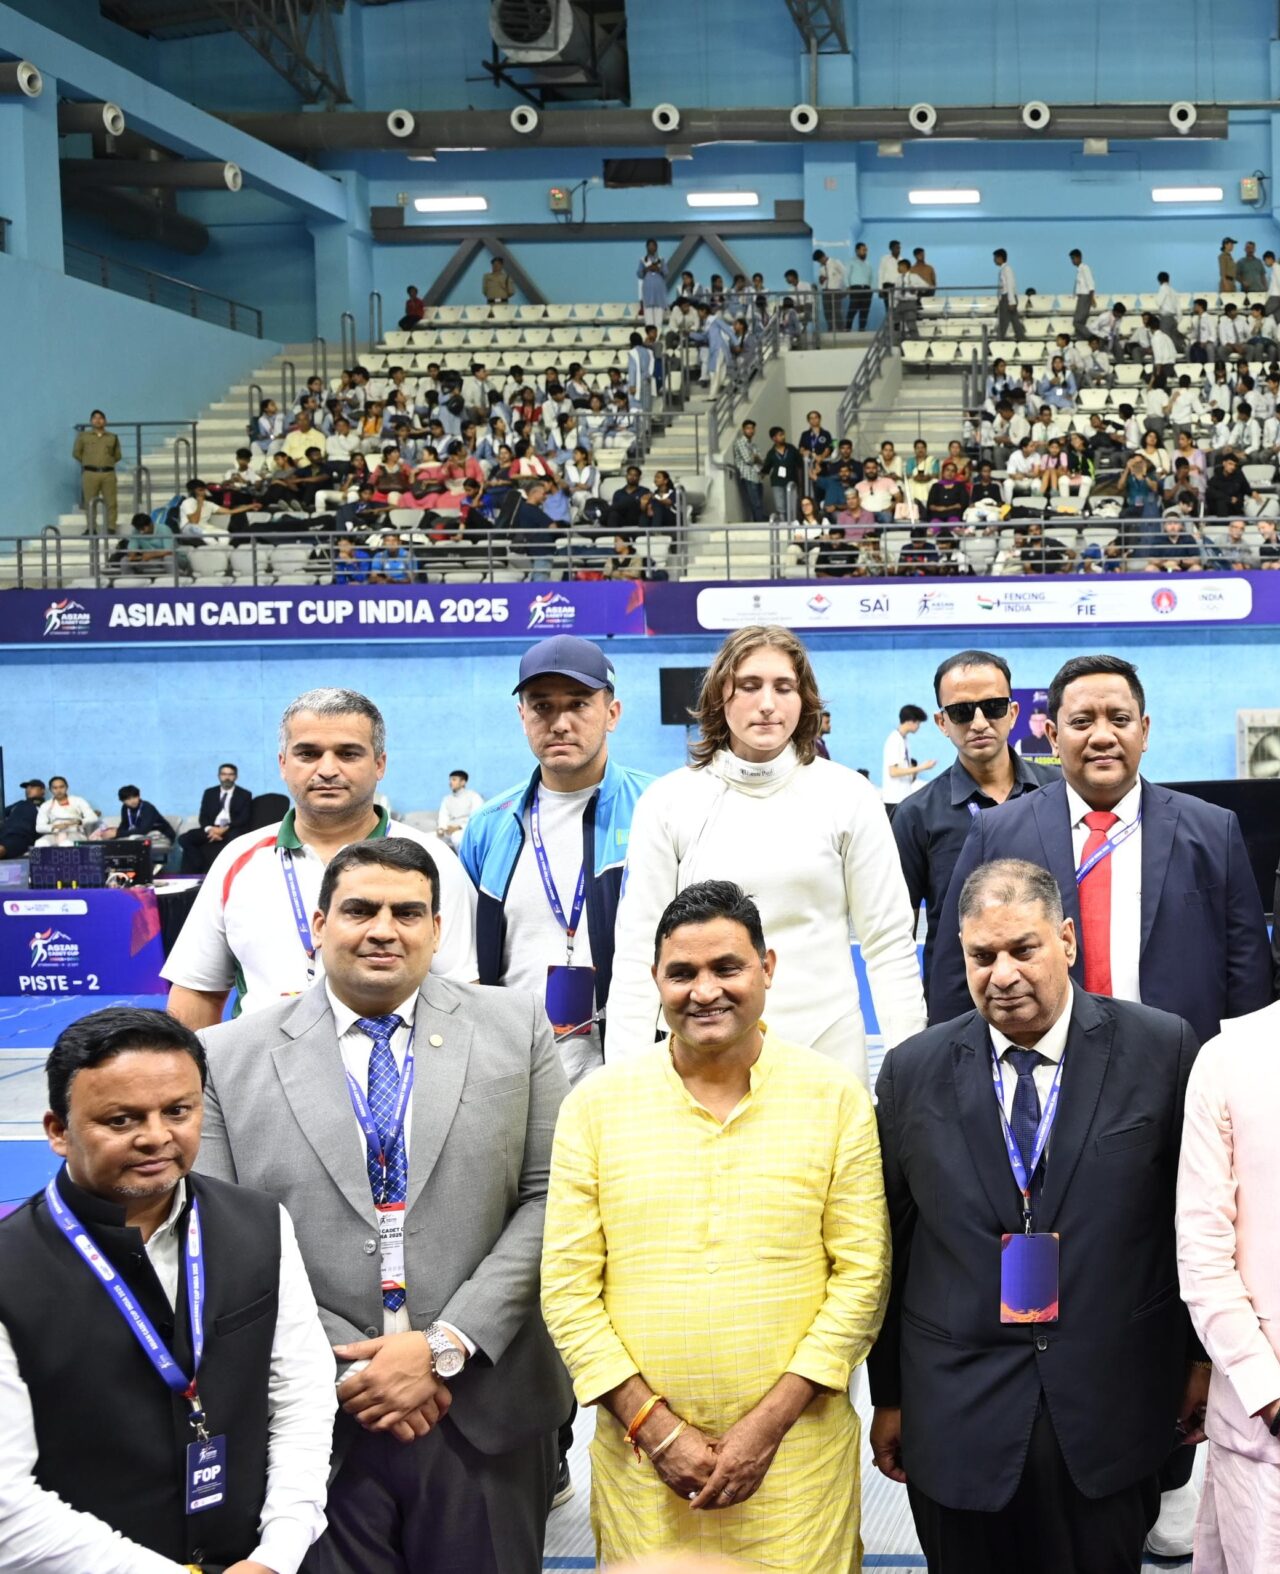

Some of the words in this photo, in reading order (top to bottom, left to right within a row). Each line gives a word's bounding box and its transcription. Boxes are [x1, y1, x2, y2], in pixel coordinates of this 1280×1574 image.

[1004, 592, 1045, 601] FENCING
[860, 598, 889, 612] SAI
[1004, 604, 1031, 612] INDIA
[1077, 605, 1096, 615] FIE
[109, 602, 195, 627] ASIAN
[200, 601, 292, 626] CADET
[298, 600, 353, 624] CUP
[358, 599, 434, 624] INDIA
[440, 598, 509, 623] 2025
[19, 975, 69, 991] PISTE
[87, 974, 100, 990] 2
[193, 1465, 222, 1486] FOP
